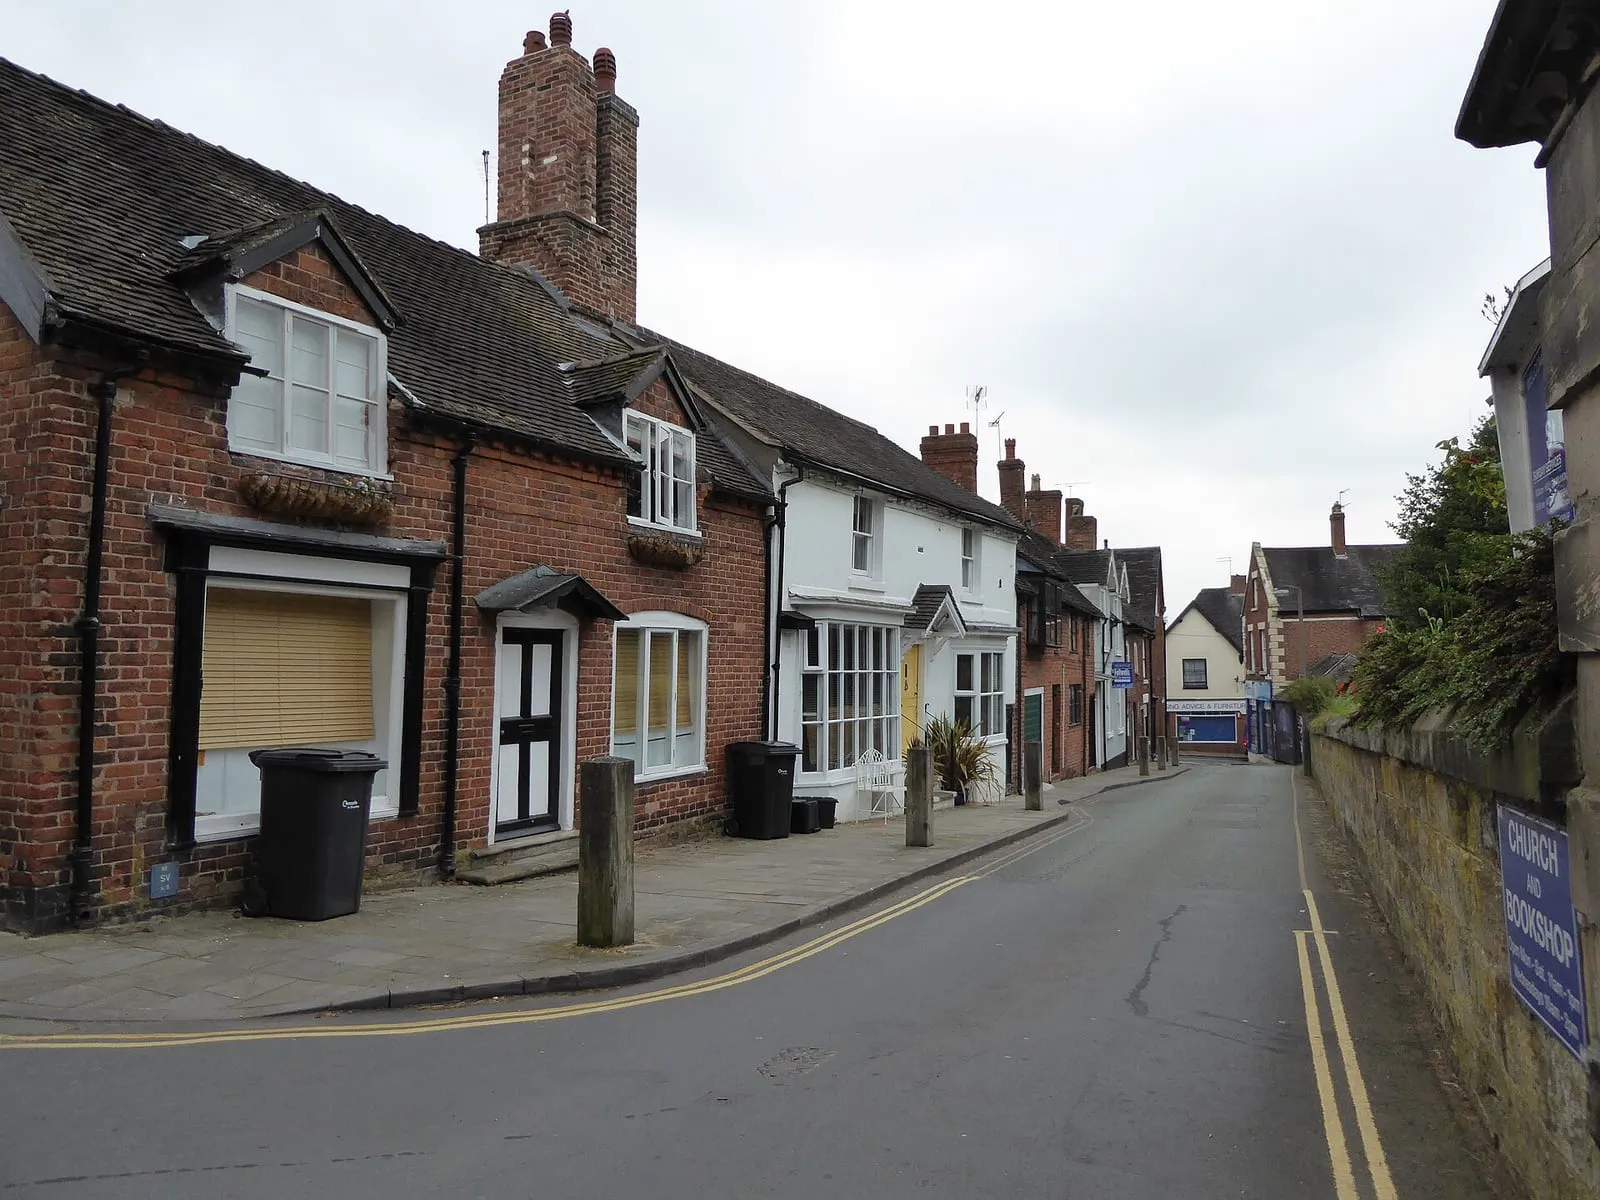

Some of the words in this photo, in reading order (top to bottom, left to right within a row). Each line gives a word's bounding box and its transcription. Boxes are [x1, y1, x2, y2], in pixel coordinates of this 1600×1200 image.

[1508, 819, 1559, 877] CHURCH
[1526, 873, 1542, 899] AND
[1505, 888, 1574, 968] BOOKSHOP
